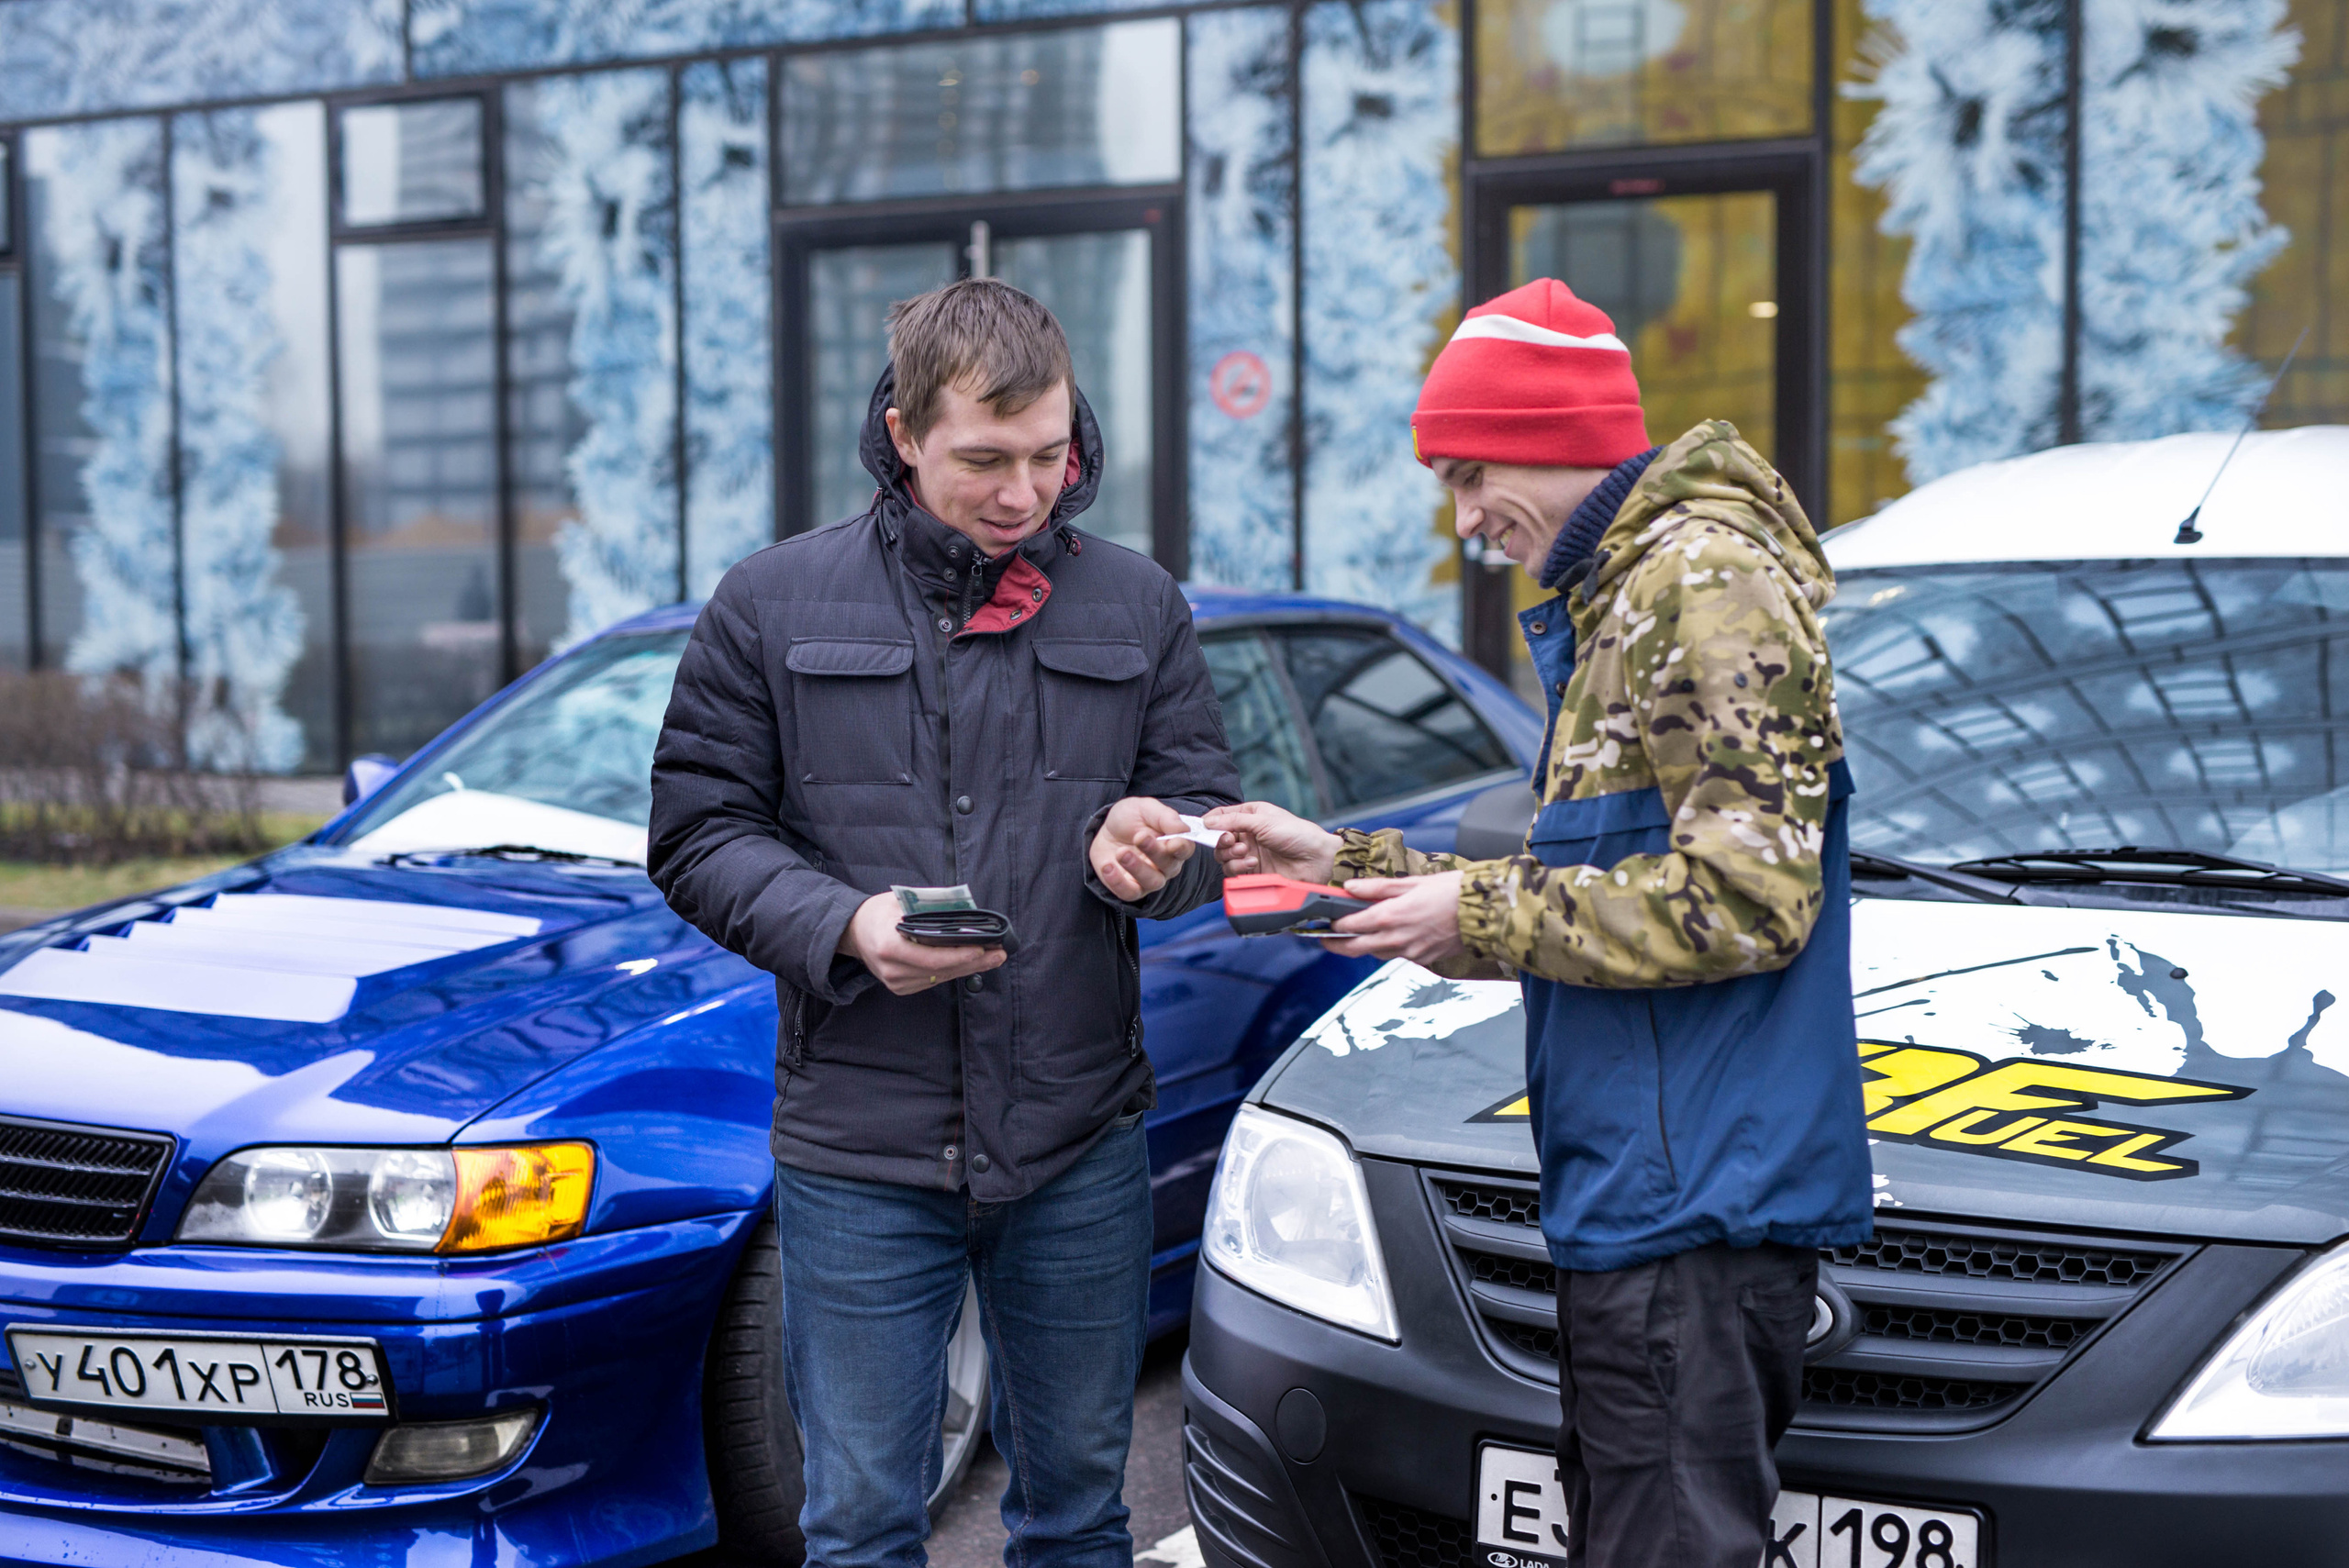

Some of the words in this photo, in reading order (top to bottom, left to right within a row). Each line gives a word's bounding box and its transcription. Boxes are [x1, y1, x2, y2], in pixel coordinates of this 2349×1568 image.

[275, 1349, 367, 1391] 178
[305, 1392, 350, 1408] RUS
[1830, 1507, 1954, 1568] 198
